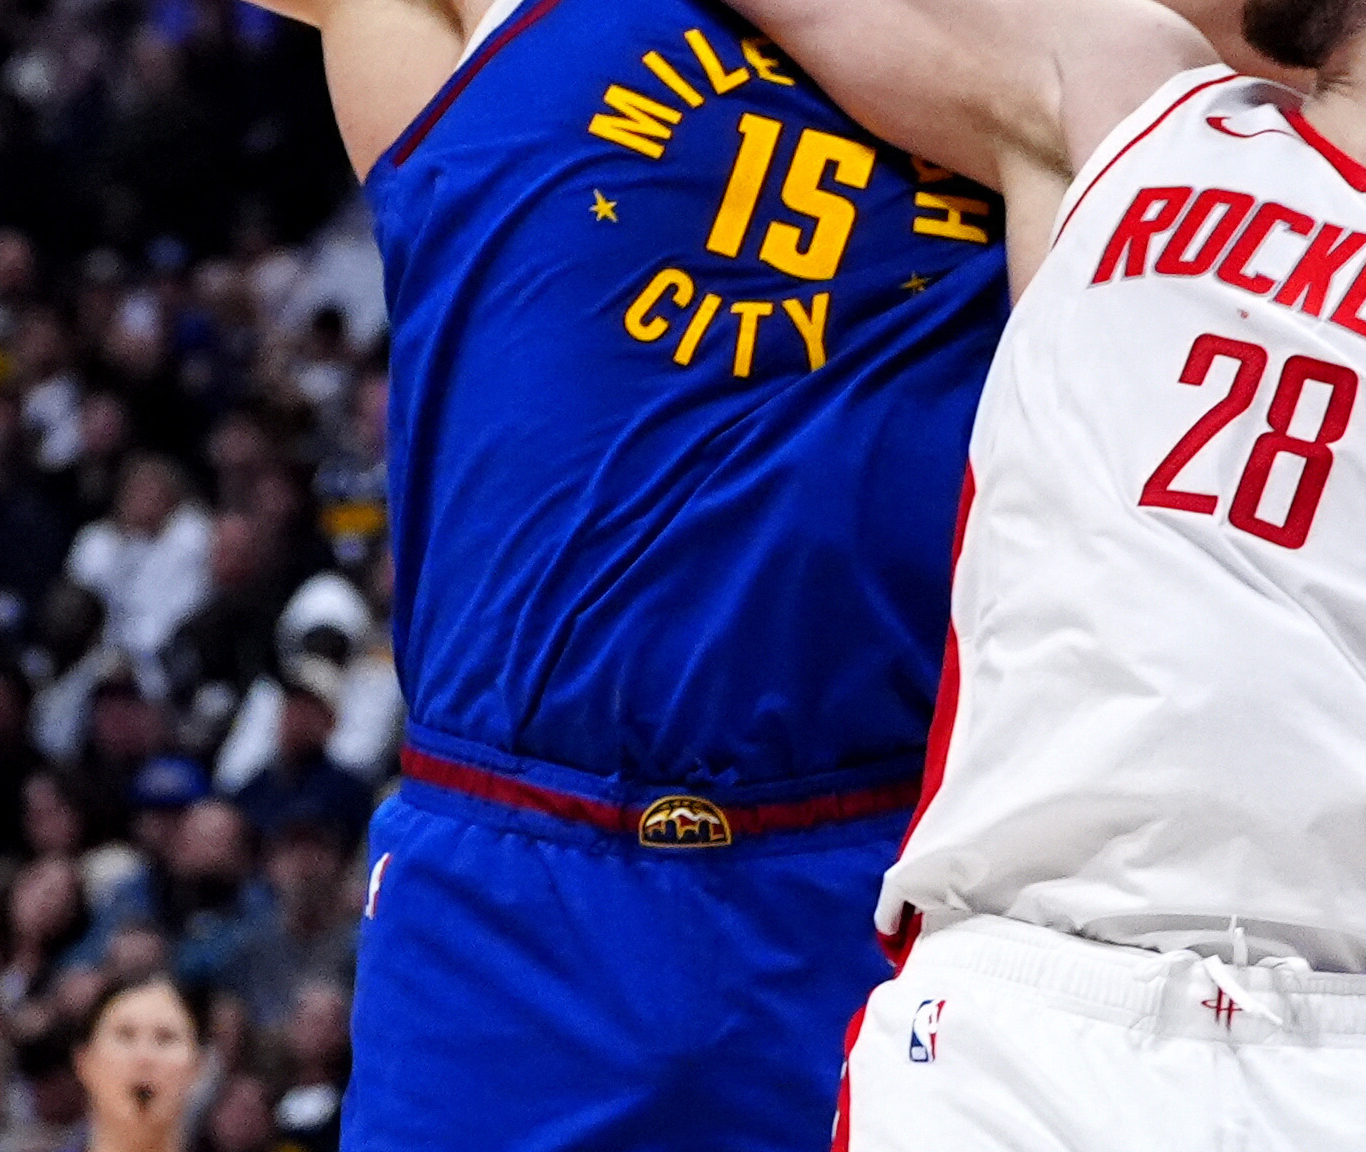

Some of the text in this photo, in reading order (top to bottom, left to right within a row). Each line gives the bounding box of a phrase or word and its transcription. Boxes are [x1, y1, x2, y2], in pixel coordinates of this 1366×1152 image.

[706, 112, 876, 280] 15
[624, 267, 830, 378] CITY
[1137, 333, 1358, 549] 28
